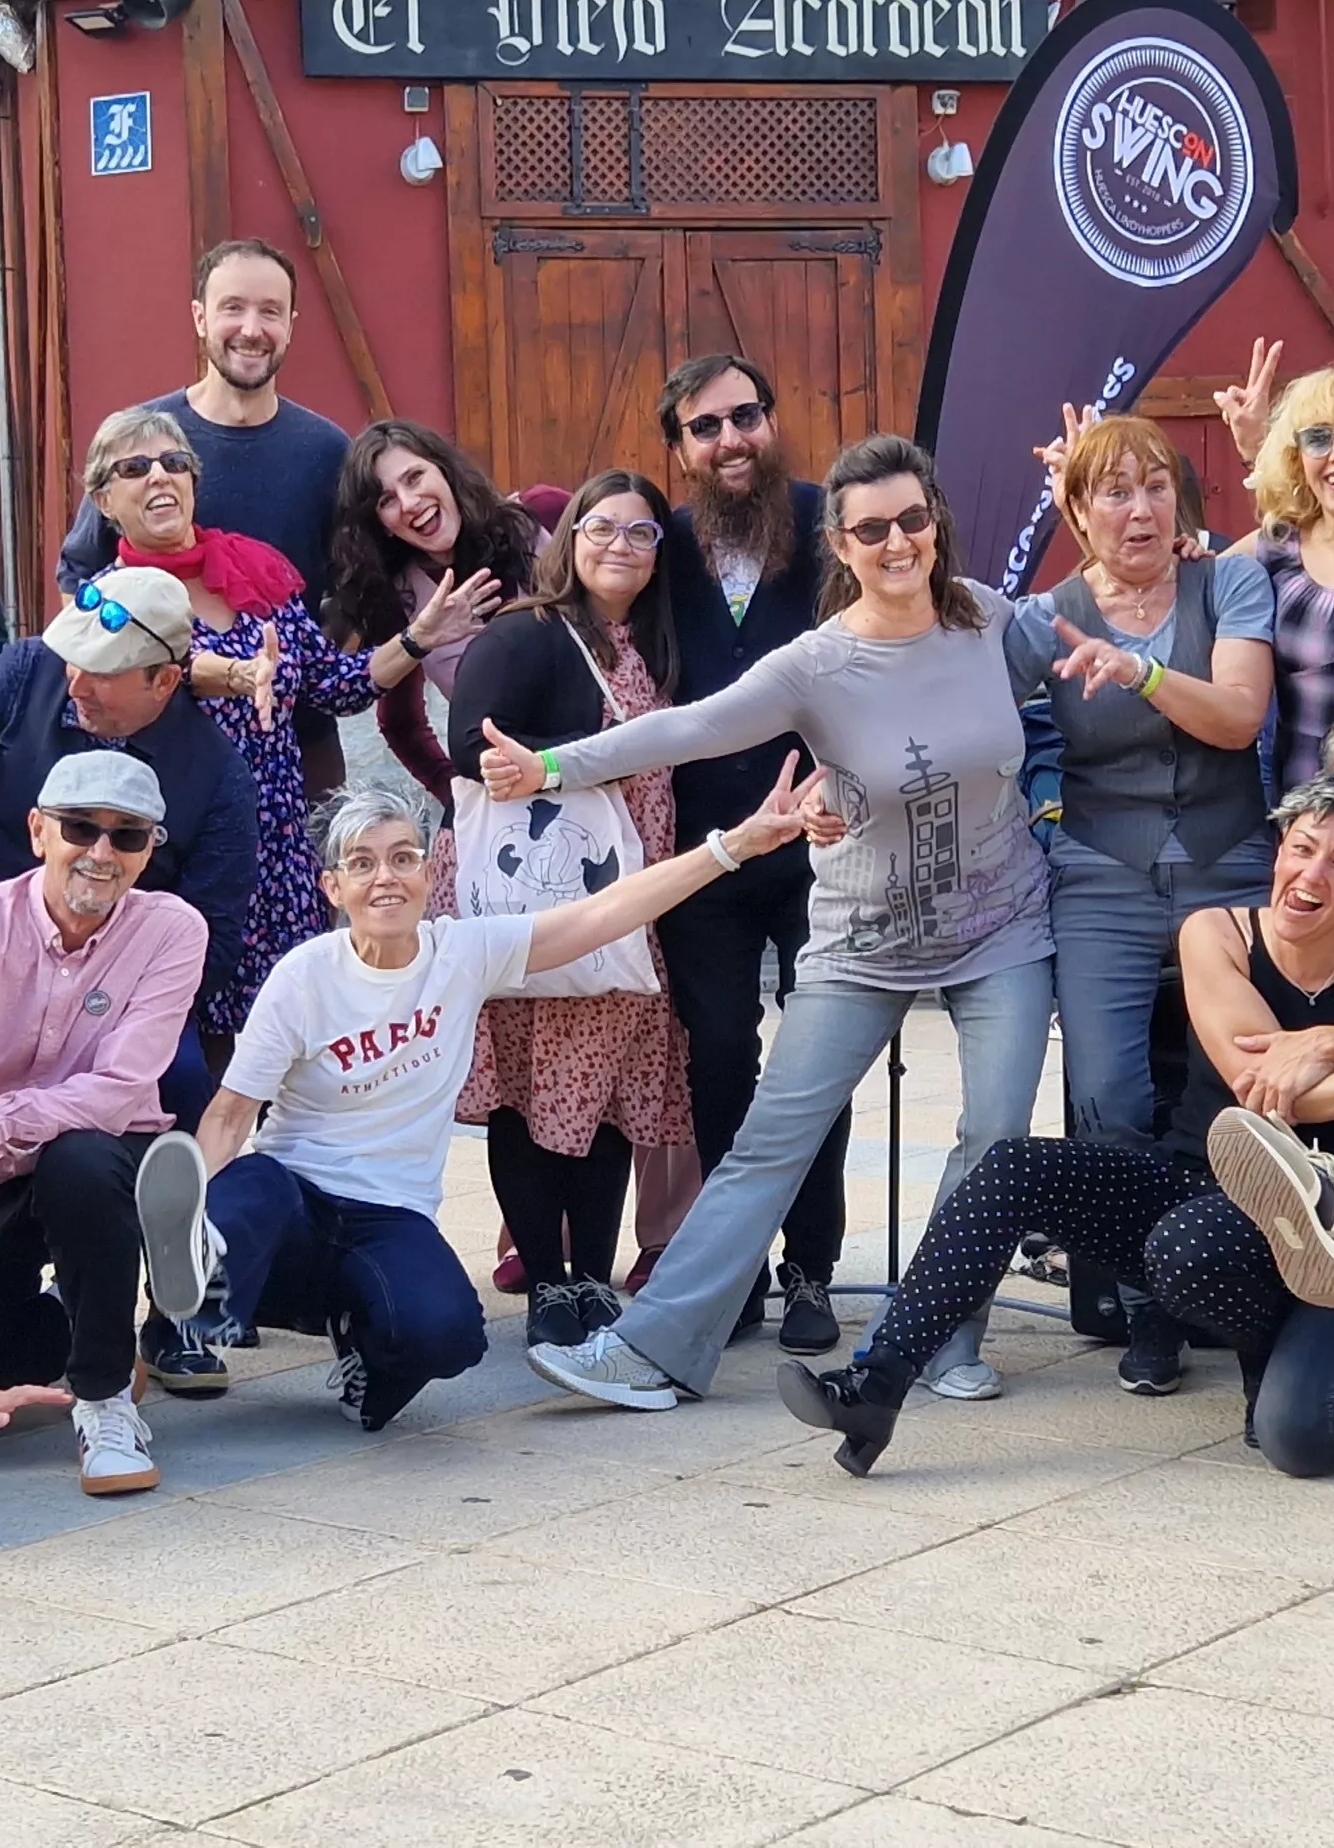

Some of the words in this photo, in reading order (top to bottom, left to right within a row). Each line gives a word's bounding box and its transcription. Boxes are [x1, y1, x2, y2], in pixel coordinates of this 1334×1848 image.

[332, 0, 426, 54] El
[1082, 102, 1225, 220] SWING
[1118, 88, 1215, 168] HUESCON
[1094, 168, 1116, 214] HUESCA
[1116, 211, 1185, 237] LINDYHOPPERS
